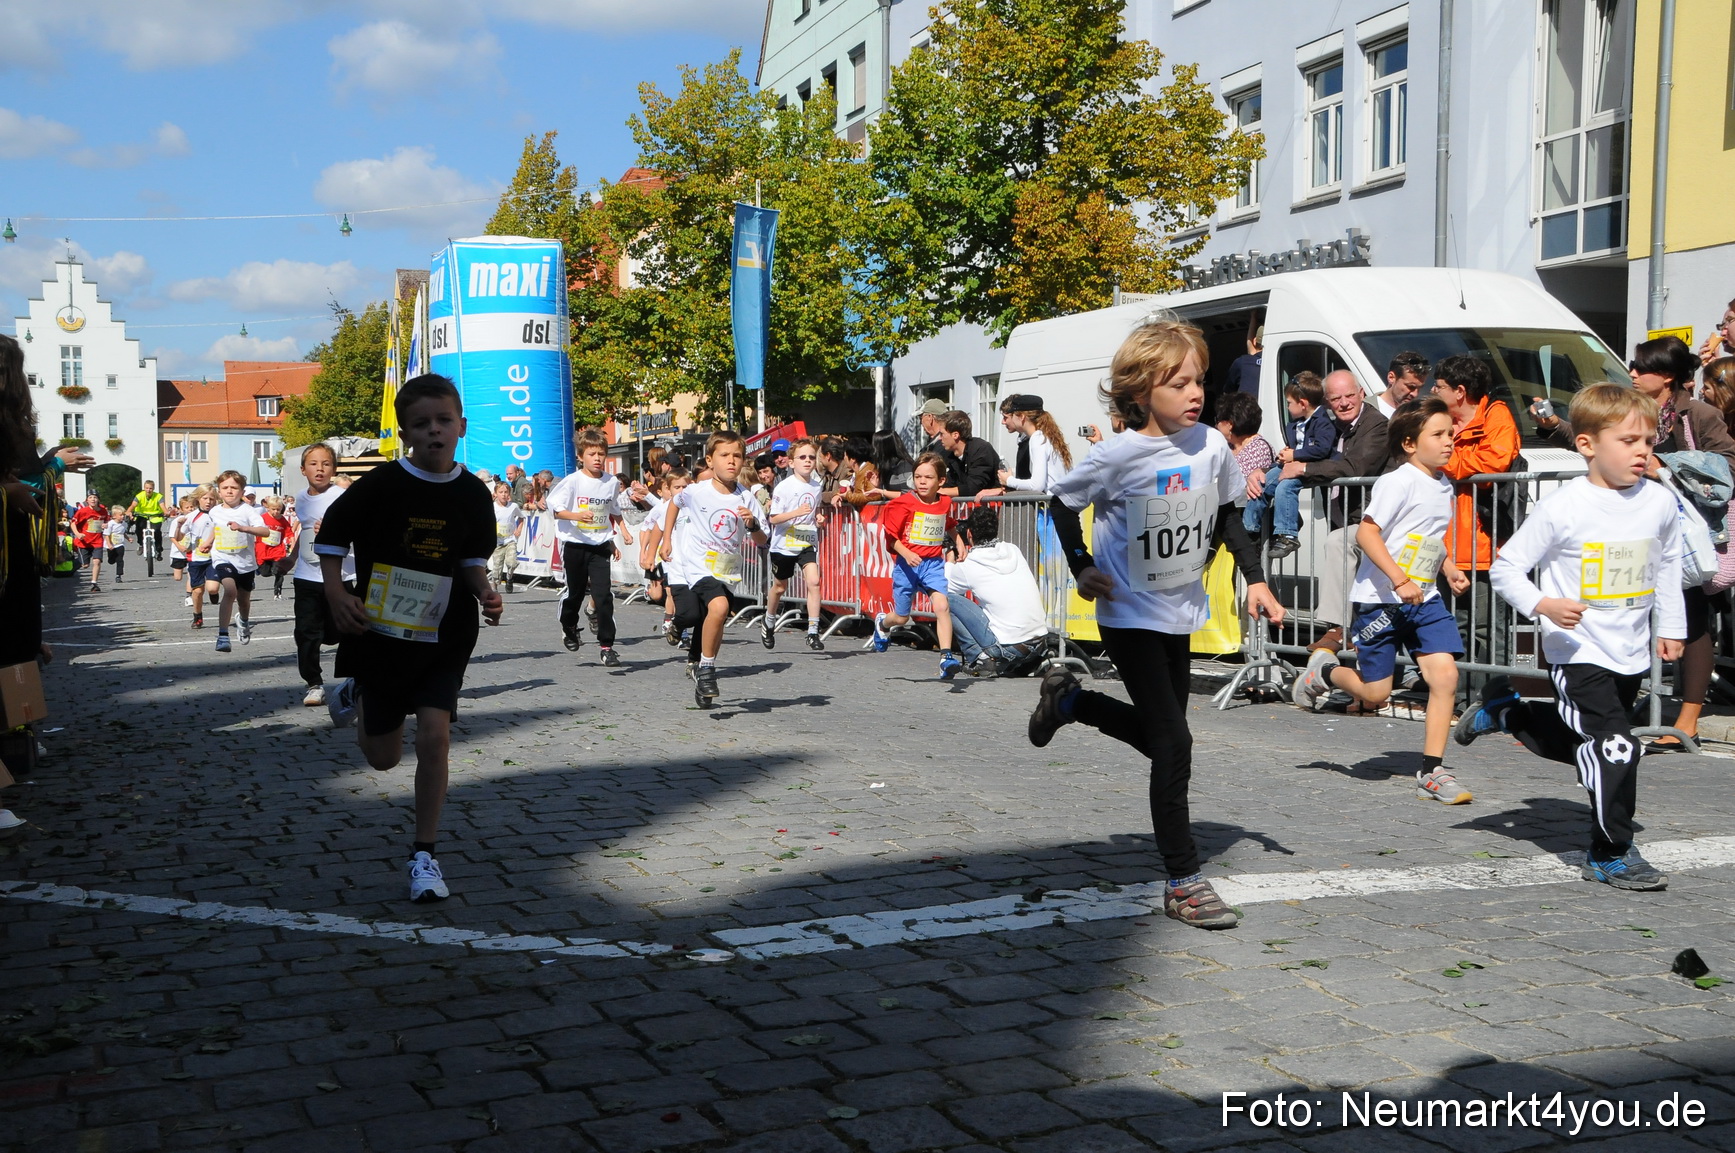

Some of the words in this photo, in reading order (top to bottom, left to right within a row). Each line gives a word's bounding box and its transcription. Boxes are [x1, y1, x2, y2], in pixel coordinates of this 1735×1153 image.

[1182, 227, 1372, 292] Raiffeisenbank
[468, 255, 551, 298] maxi
[432, 322, 448, 350] dsl
[522, 319, 550, 345] dsl
[593, 515, 607, 524] 267
[1143, 493, 1207, 529] Ben
[795, 533, 816, 543] 7105
[923, 525, 944, 536] 7288
[1136, 514, 1213, 560] 10214
[1607, 546, 1634, 561] Felix
[392, 571, 435, 594] Hannes
[1585, 567, 1598, 578] K4
[1607, 561, 1655, 587] 7143
[391, 594, 442, 621] 7274
